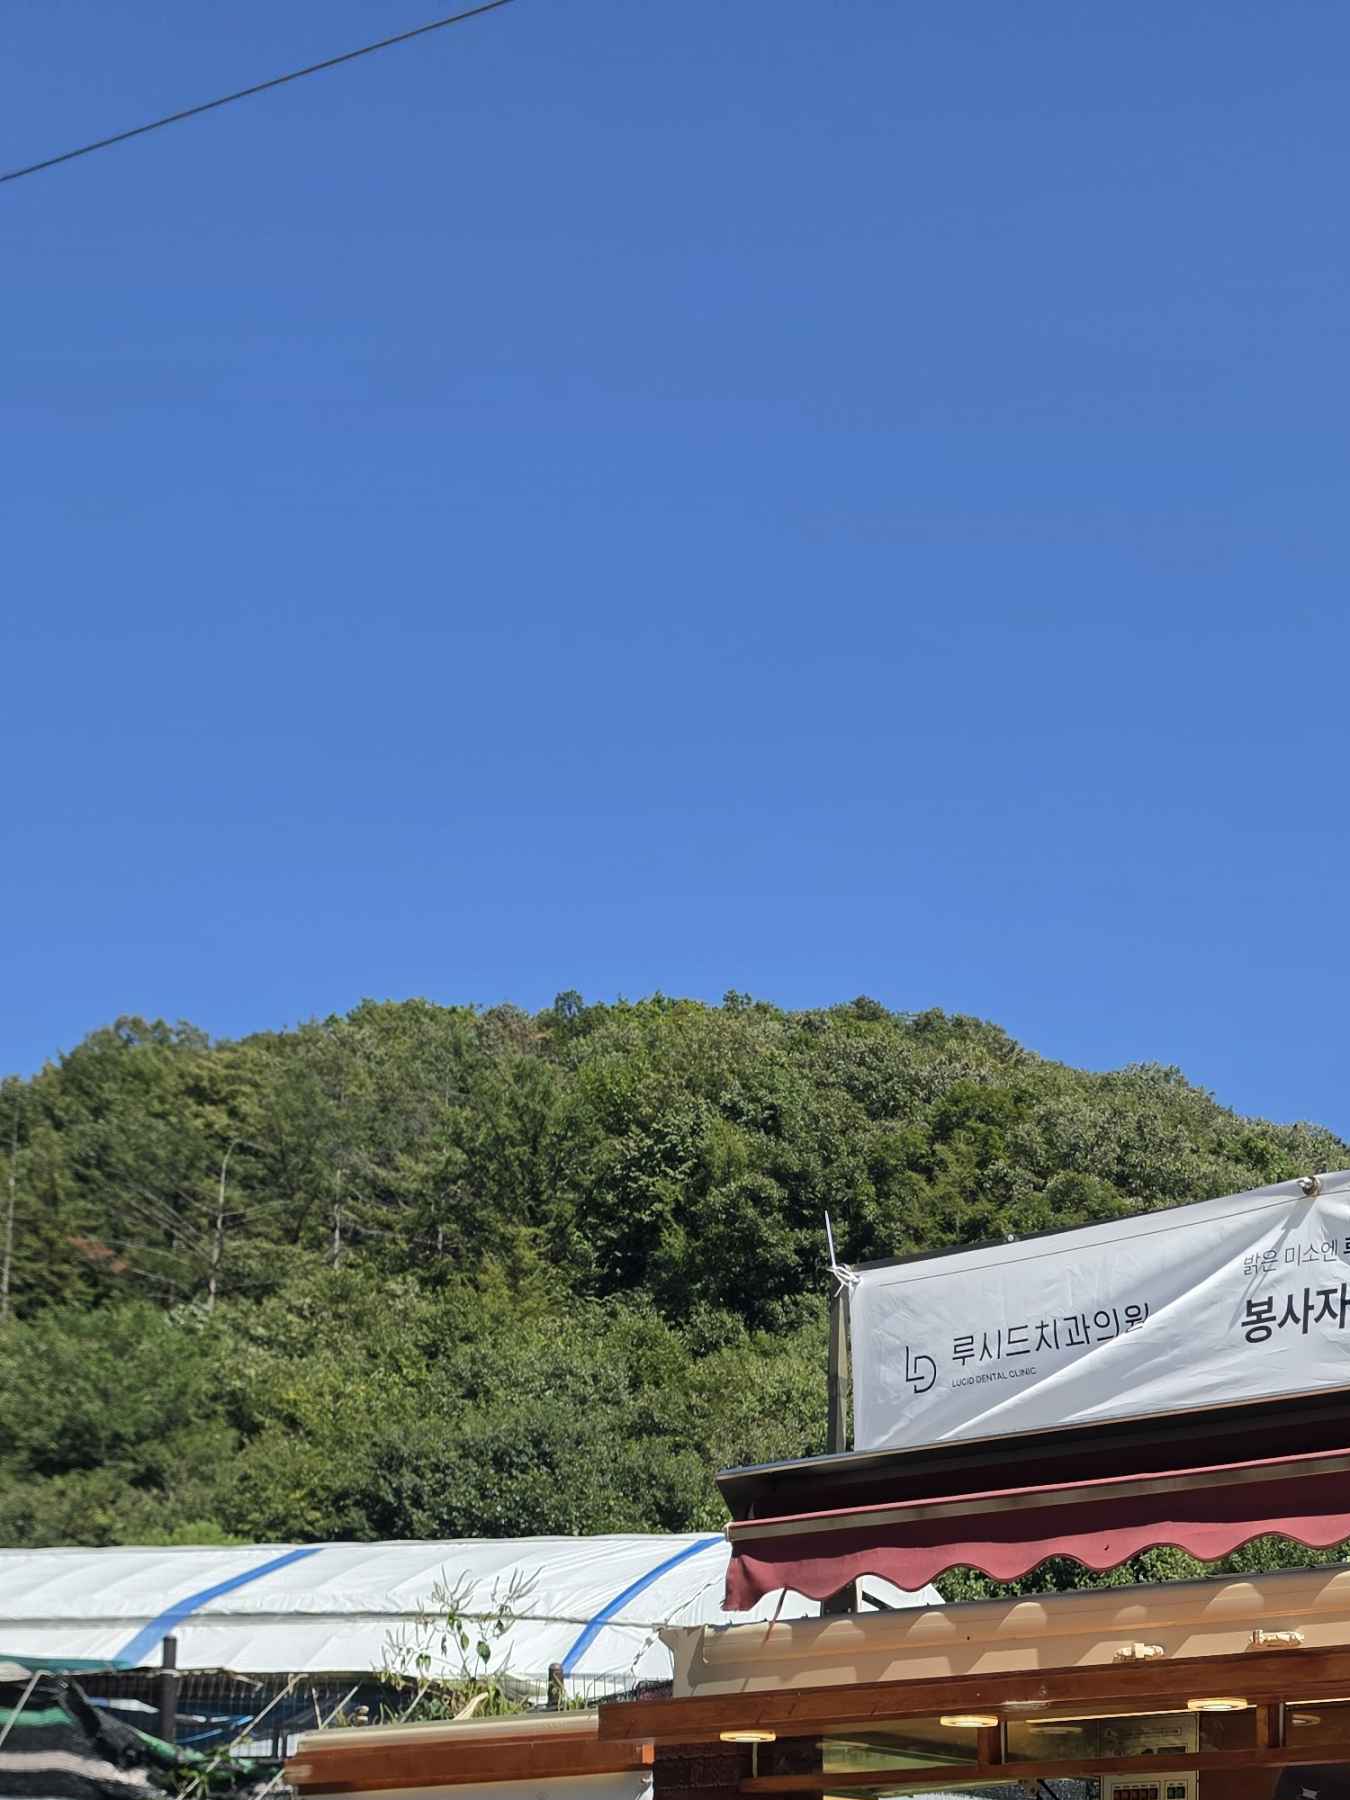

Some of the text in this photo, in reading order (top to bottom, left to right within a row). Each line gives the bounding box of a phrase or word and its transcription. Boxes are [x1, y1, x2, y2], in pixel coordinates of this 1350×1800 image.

[1242, 1250, 1277, 1276] 밝은
[1283, 1238, 1337, 1265] 미소엔
[951, 1302, 1152, 1366] 루시드치과의원
[951, 1367, 1037, 1388] LUCID DENTAL CLINIC
